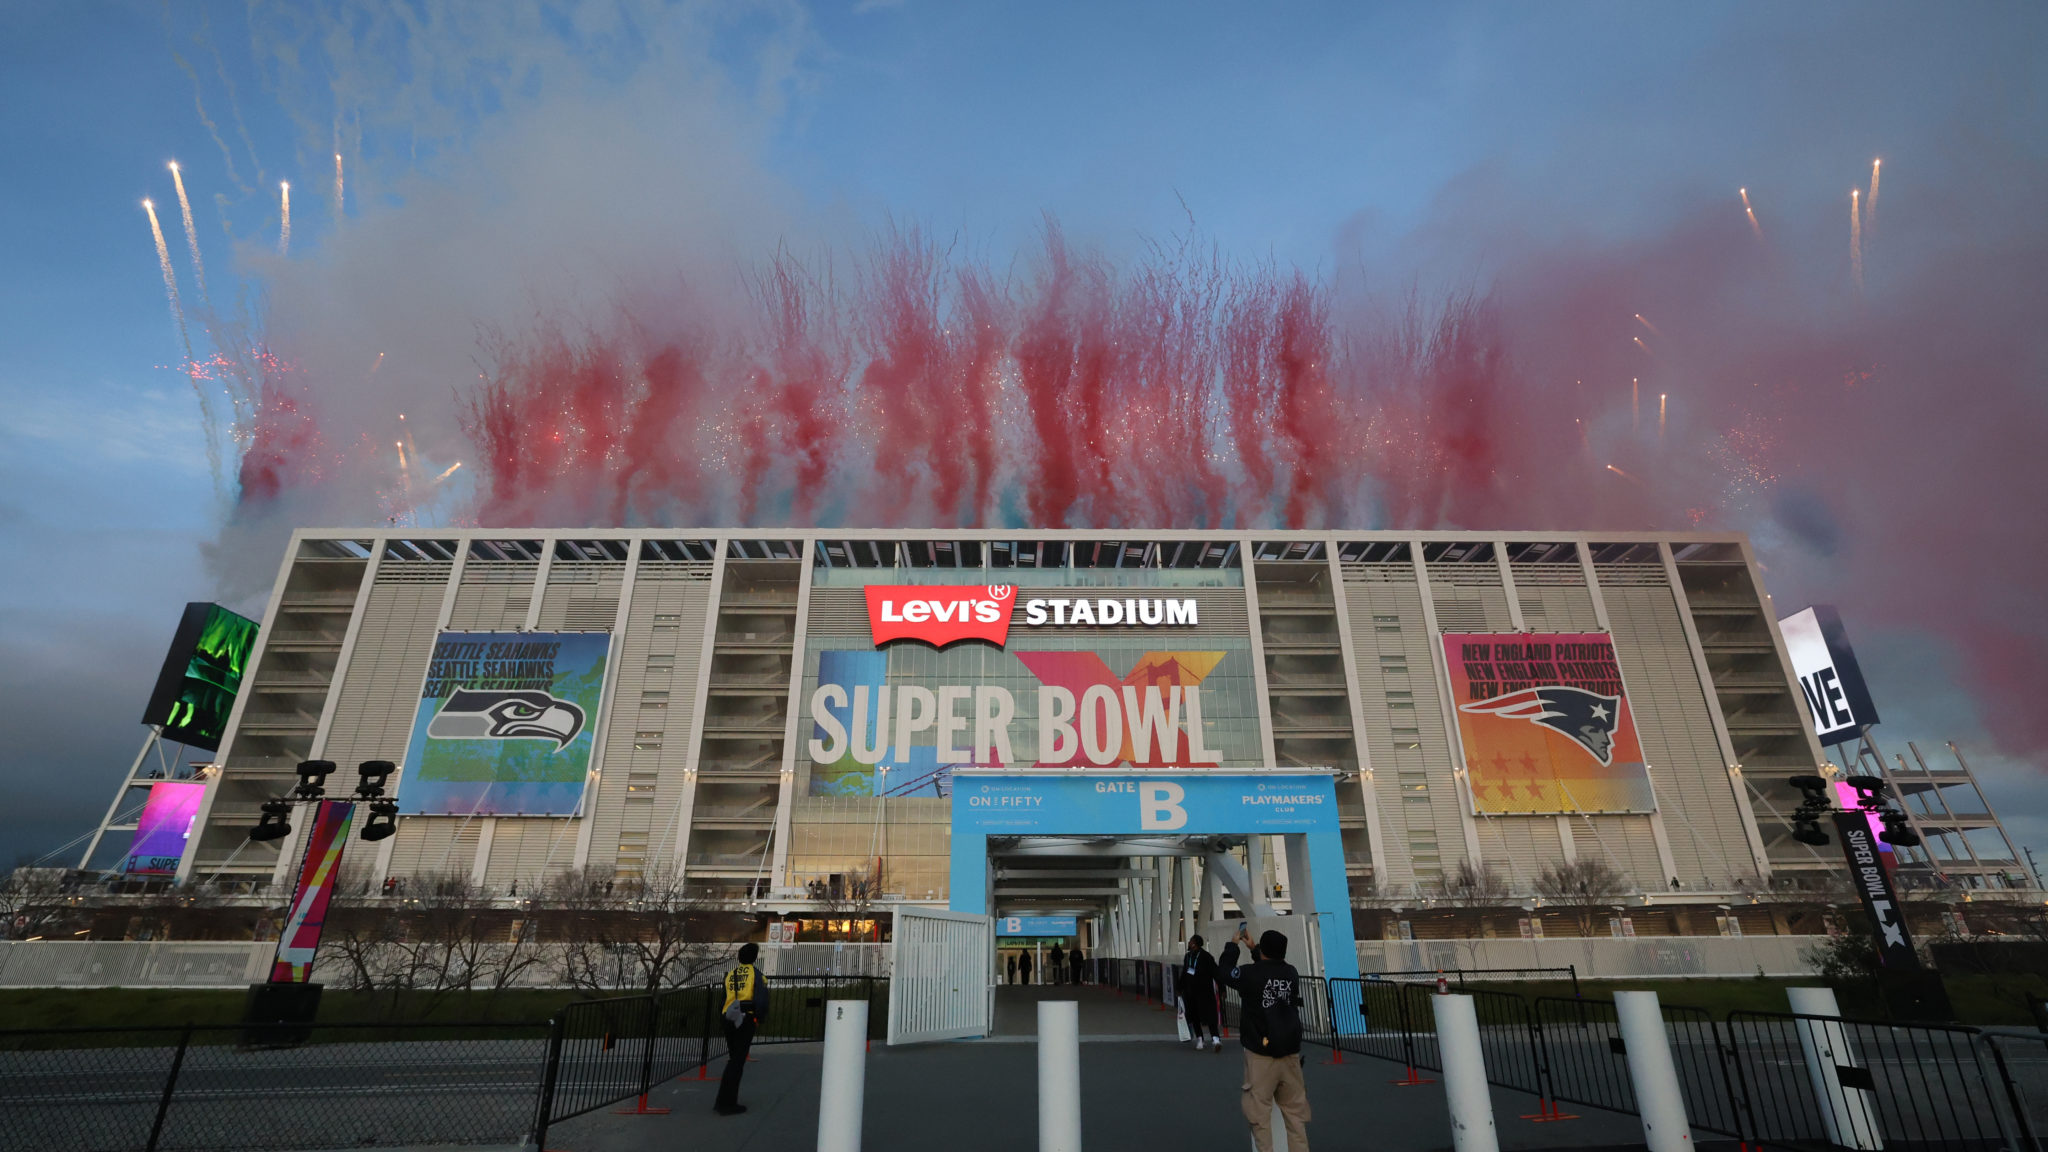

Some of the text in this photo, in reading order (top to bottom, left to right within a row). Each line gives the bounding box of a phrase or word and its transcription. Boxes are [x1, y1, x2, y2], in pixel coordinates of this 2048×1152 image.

[1026, 599, 1198, 626] STADIUM
[432, 642, 561, 660] SEATTLE SEAHAWKS
[1462, 643, 1615, 661] NEW ENGLAND PATRIOTS
[428, 661, 554, 679] SEATTLE SEAHAWKS
[1464, 662, 1621, 680] NEW ENGLAND PATRIOTS
[1470, 682, 1498, 699] NEW
[1799, 666, 1852, 729] VE
[808, 684, 1224, 766] SUPER BOWL
[1095, 781, 1136, 793] GATE
[969, 796, 991, 806] ON
[1002, 796, 1042, 806] FIFTY
[1139, 781, 1188, 830] B
[1847, 830, 1887, 898] SUPER BOWL
[1007, 917, 1021, 933] B
[1265, 979, 1292, 991] APEX
